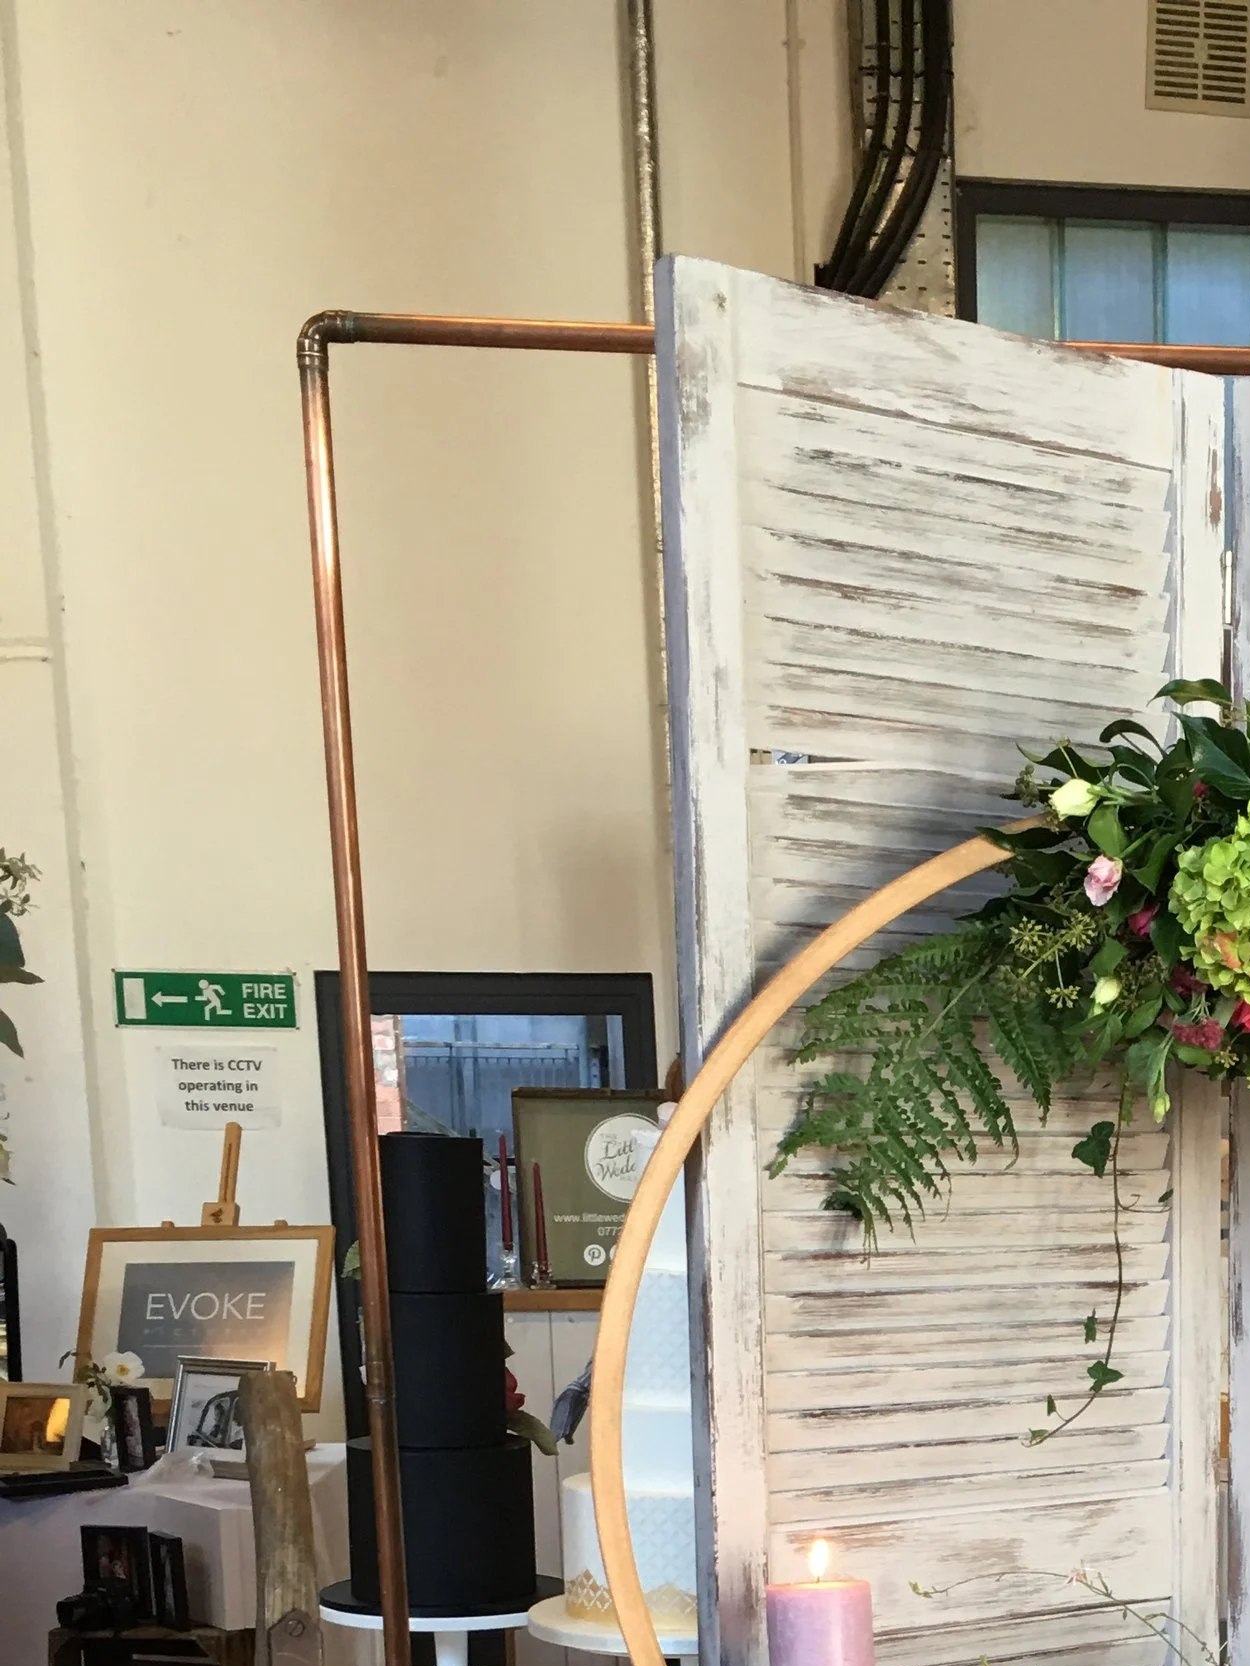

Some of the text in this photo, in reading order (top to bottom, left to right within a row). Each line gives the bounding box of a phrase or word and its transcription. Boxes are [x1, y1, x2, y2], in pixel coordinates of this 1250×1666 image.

[241, 983, 287, 999] FIRE
[243, 1003, 287, 1019] EXIT
[171, 1058, 262, 1071] There is CCTV
[178, 1080, 258, 1093] operating in
[184, 1099, 254, 1112] this venue
[146, 1292, 267, 1320] EVOKE
